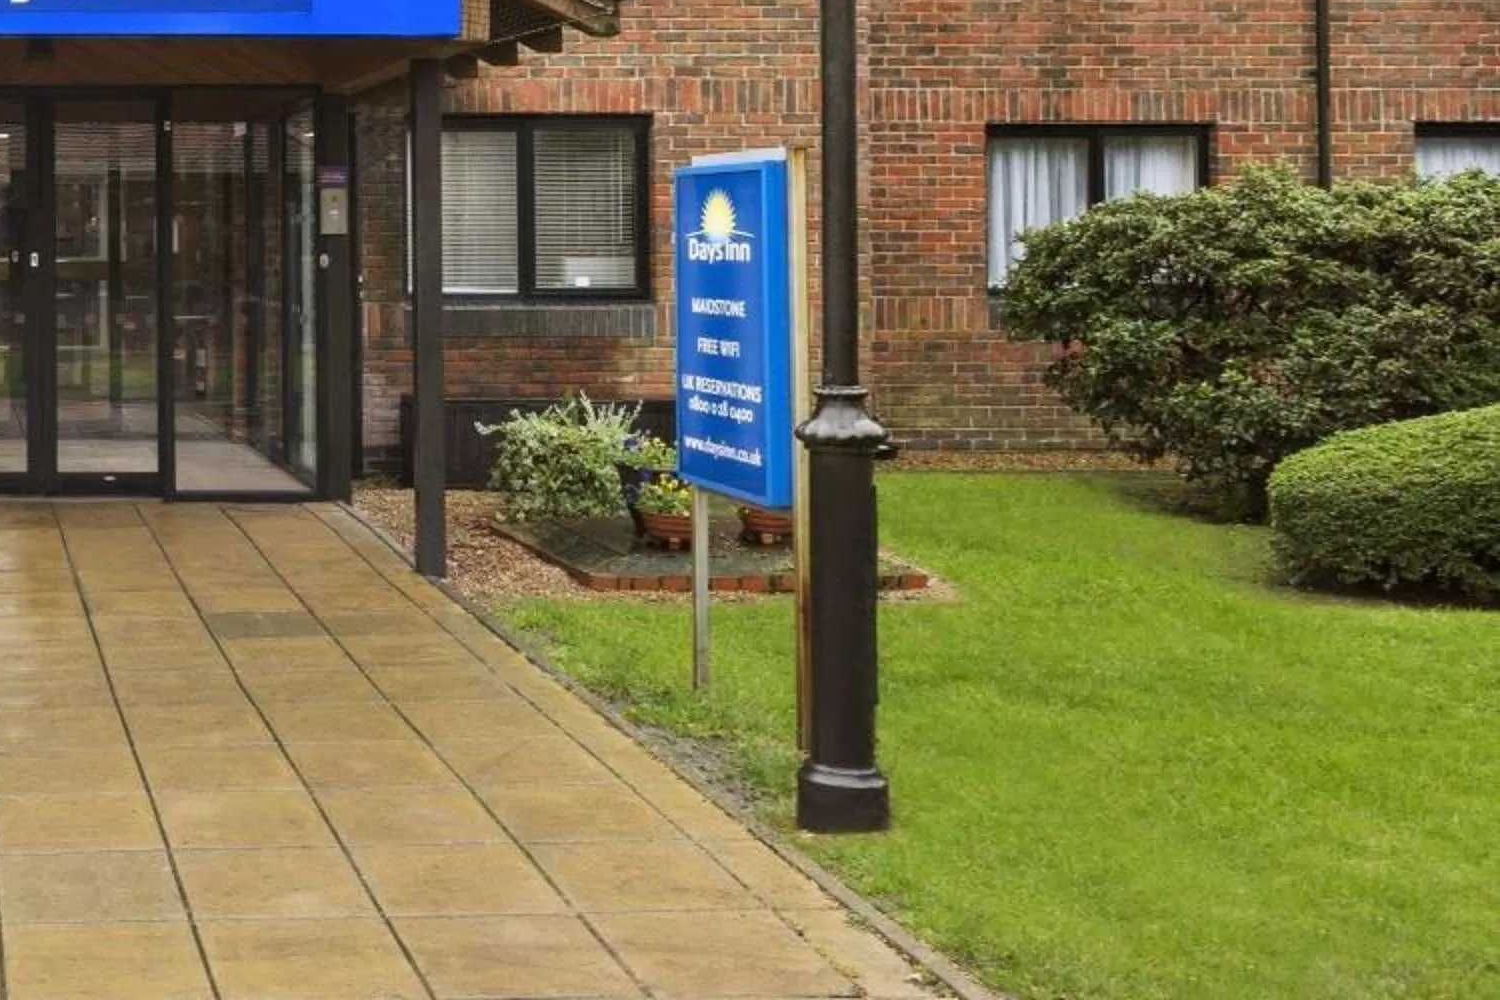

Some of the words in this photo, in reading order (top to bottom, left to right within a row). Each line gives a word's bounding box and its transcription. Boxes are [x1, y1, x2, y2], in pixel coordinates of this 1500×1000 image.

[689, 237, 724, 265] Days
[725, 241, 752, 262] Inn
[691, 296, 747, 318] MAIDSTONE
[697, 336, 719, 355] FREE
[682, 374, 695, 391] UK
[696, 375, 762, 404] RESERVATIONS
[729, 406, 753, 425] 0400
[683, 434, 762, 467] www.daysinn.co.uk
